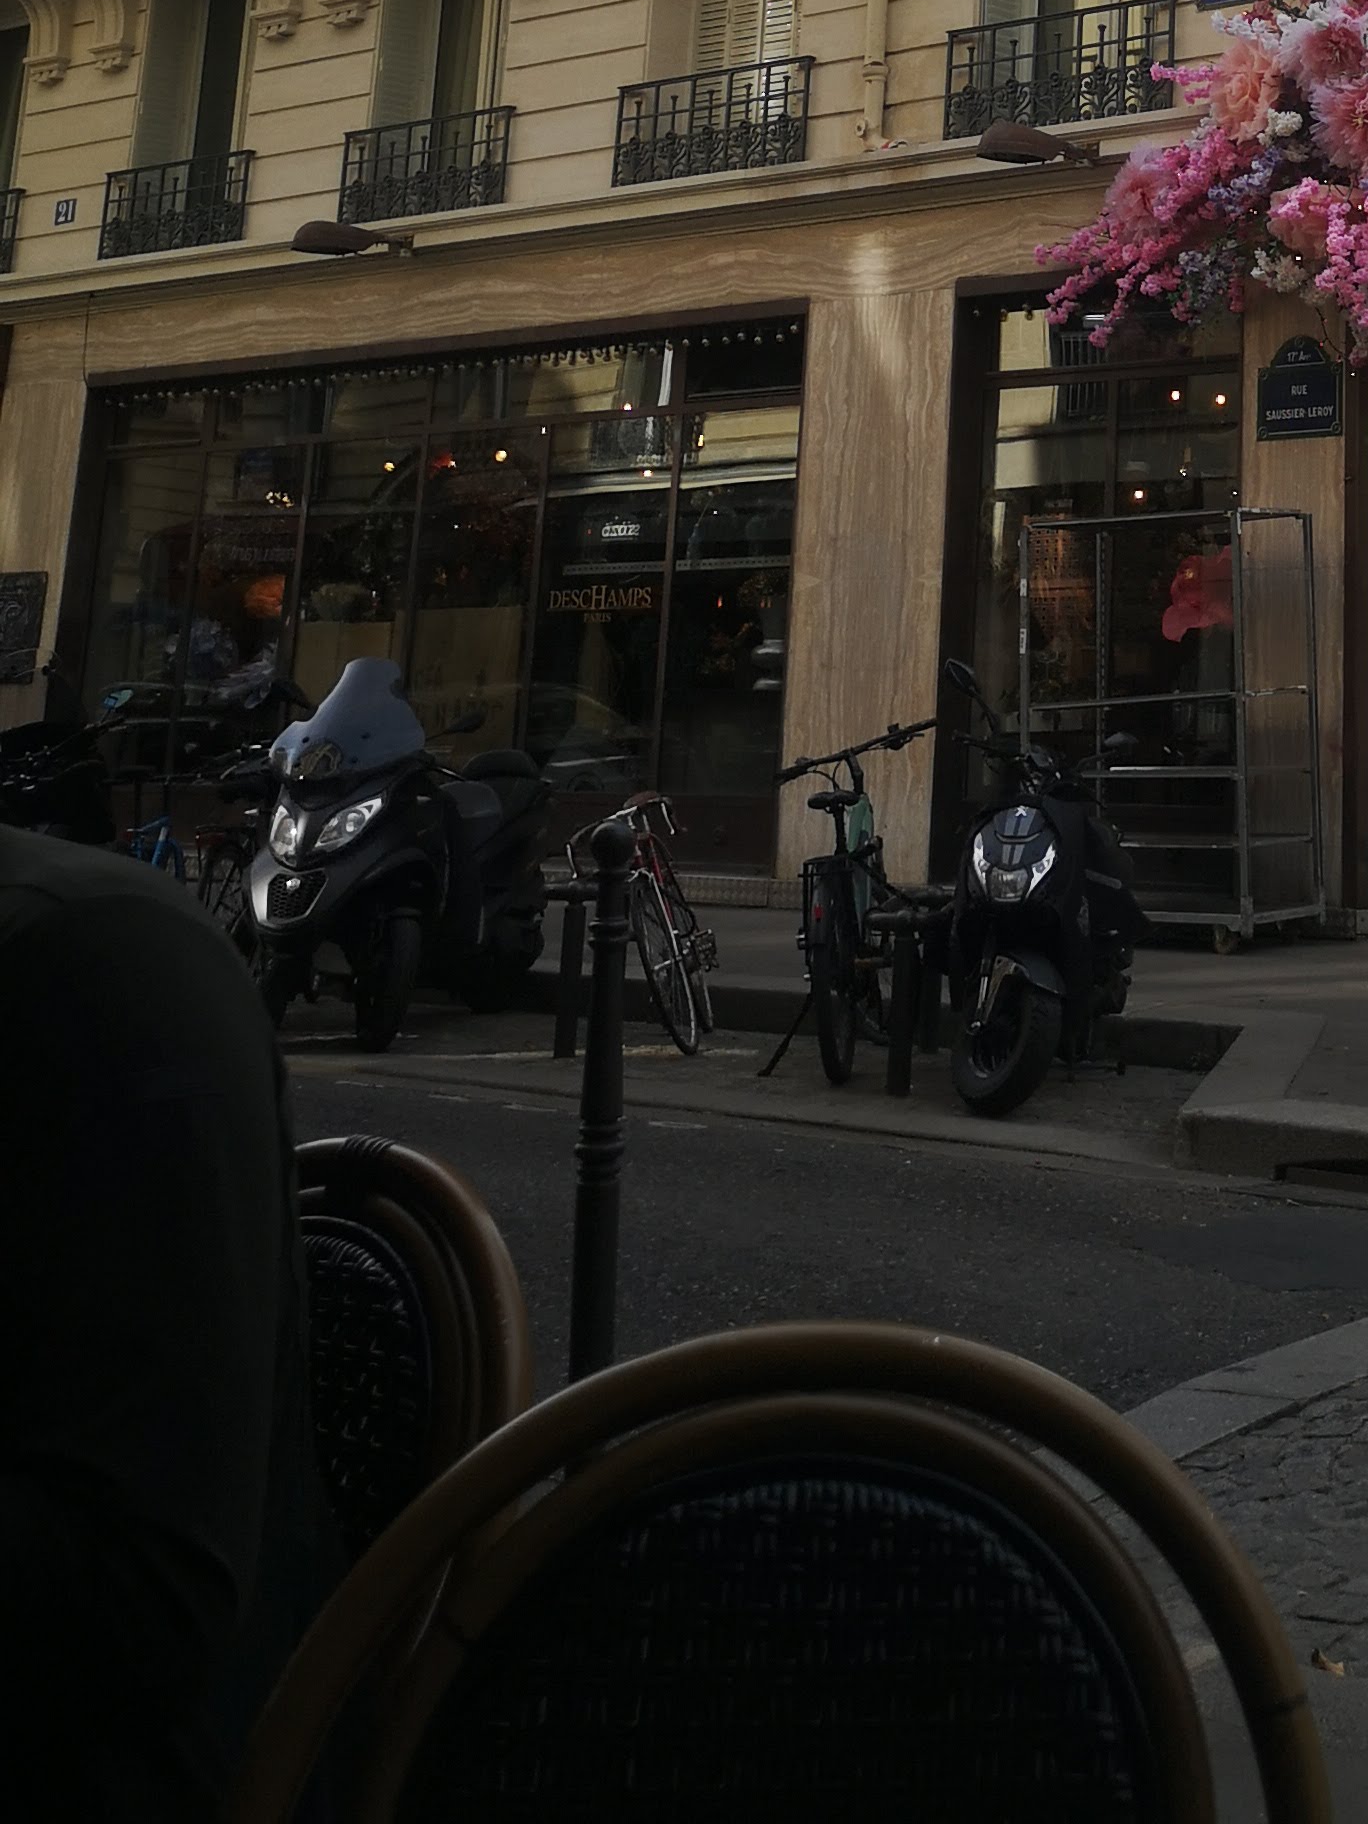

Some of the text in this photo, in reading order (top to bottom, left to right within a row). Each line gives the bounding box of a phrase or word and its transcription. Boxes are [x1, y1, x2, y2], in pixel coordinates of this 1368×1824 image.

[57, 200, 74, 223] 21
[1290, 384, 1308, 396] RUE
[549, 584, 654, 611] DESCHAMPS
